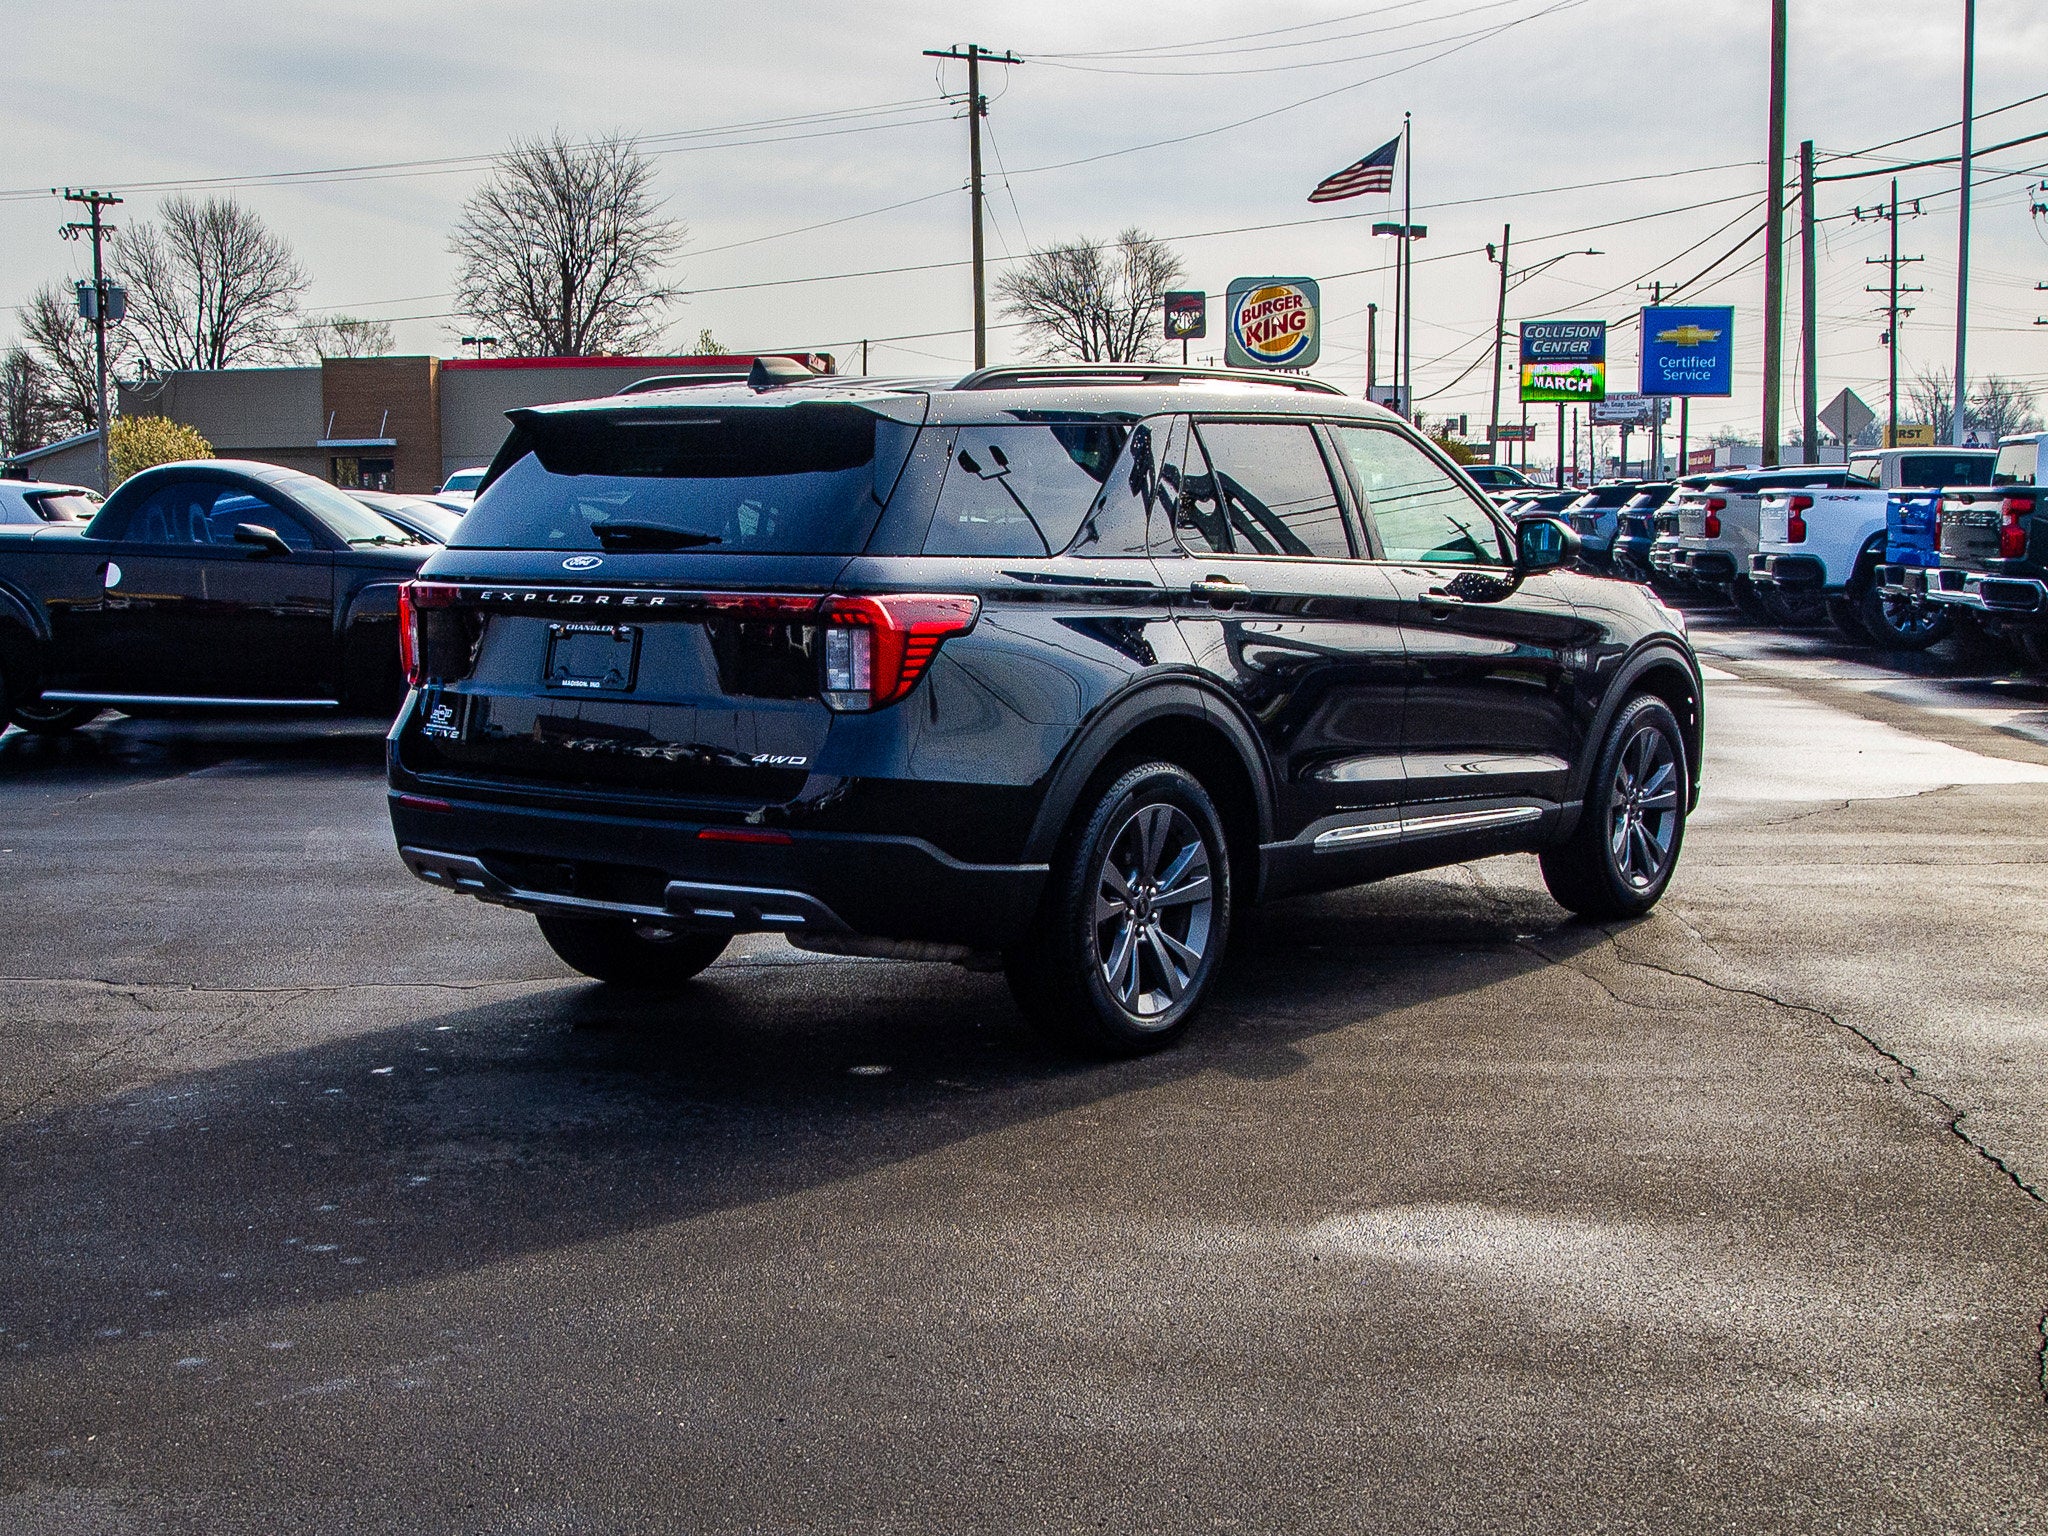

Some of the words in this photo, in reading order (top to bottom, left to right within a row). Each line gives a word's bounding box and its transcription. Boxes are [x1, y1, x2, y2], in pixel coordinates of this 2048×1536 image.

[1241, 294, 1303, 326] BURGER
[1246, 311, 1306, 347] KING
[1523, 325, 1600, 339] COLLISION
[1532, 340, 1590, 353] CENTER
[1659, 356, 1716, 368] Certified
[1663, 369, 1711, 381] Service
[1533, 376, 1593, 393] MARCH
[569, 556, 595, 567] Ford
[480, 591, 666, 605] EXPLORER
[751, 753, 807, 765] 4WD
